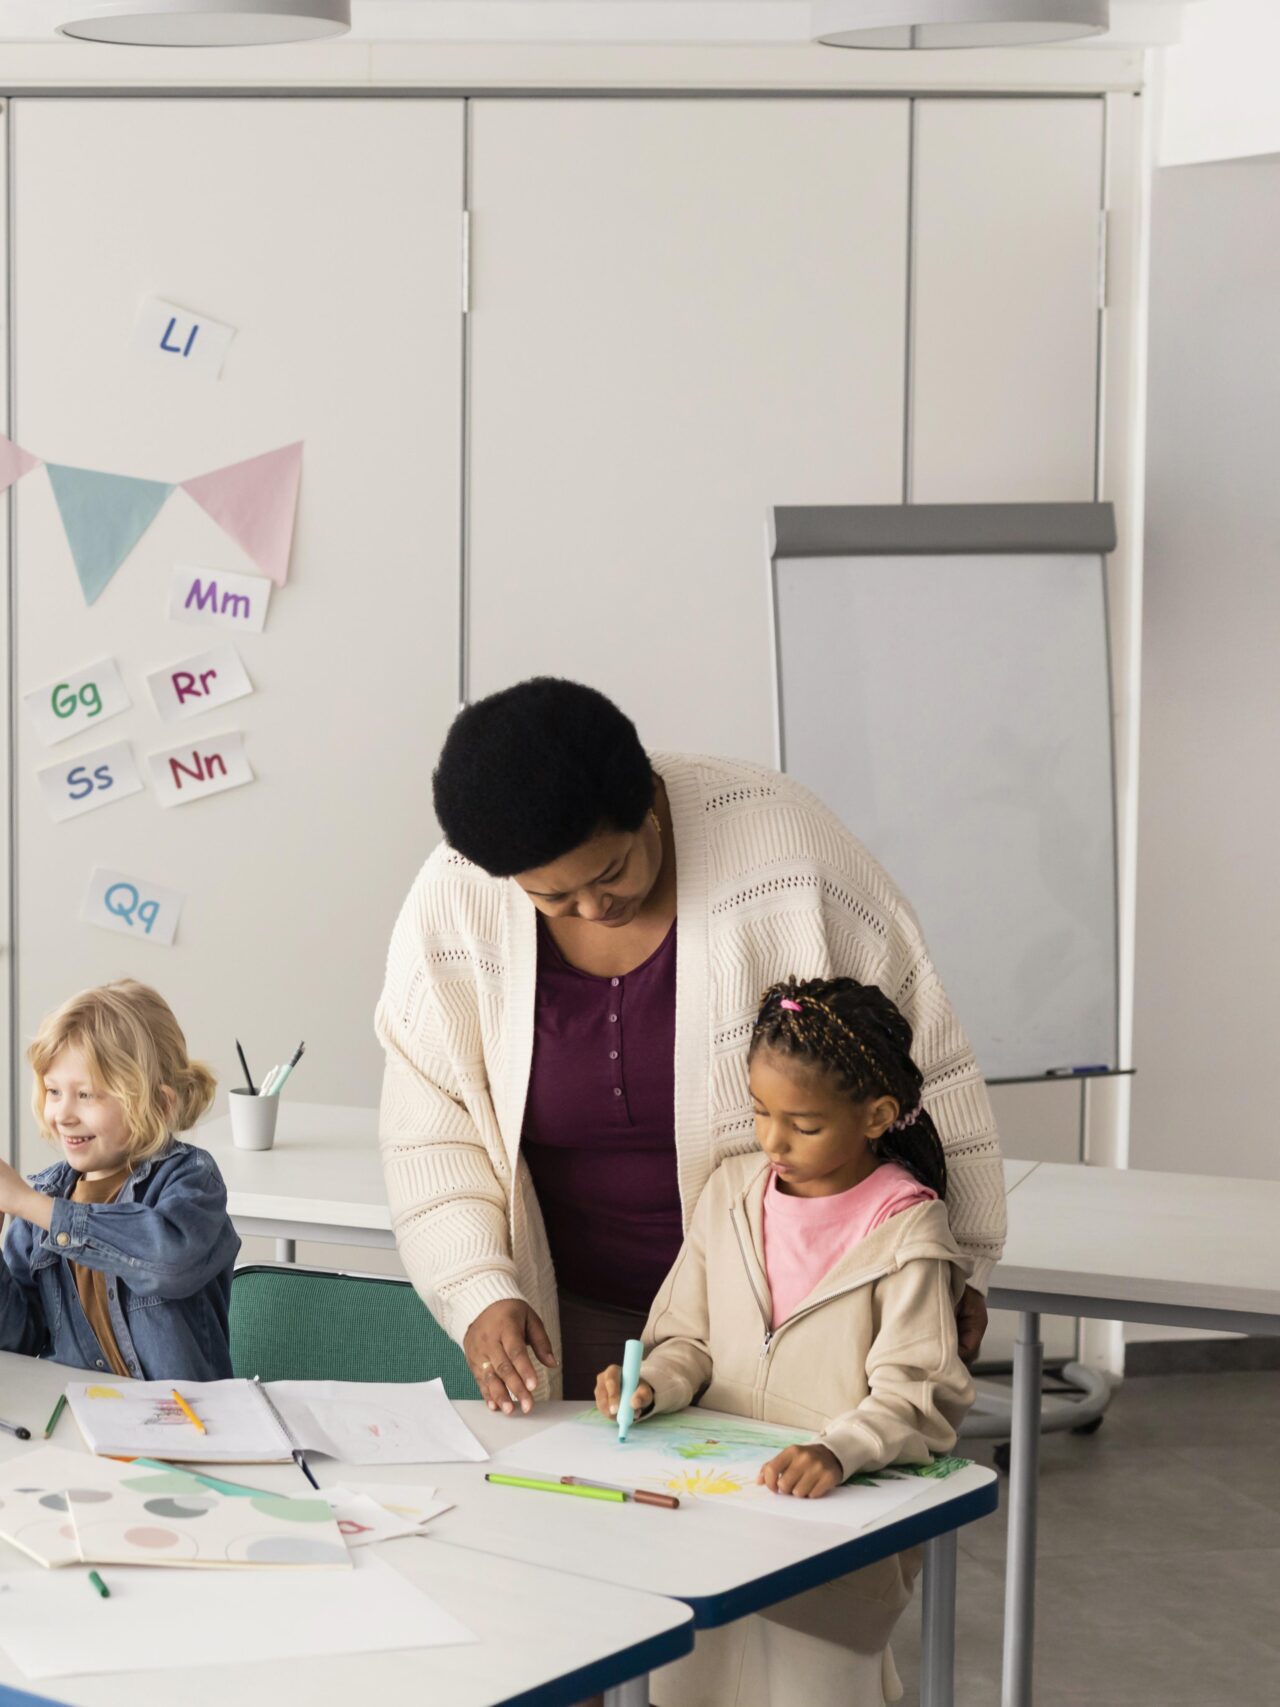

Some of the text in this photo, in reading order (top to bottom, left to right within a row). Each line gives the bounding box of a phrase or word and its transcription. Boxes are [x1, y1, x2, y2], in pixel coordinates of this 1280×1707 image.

[185, 579, 250, 618] Mm
[51, 683, 102, 718] Gg
[172, 670, 216, 704] Rr
[67, 765, 113, 799] Ss
[169, 751, 227, 788] Nn
[104, 883, 160, 934] Qq
